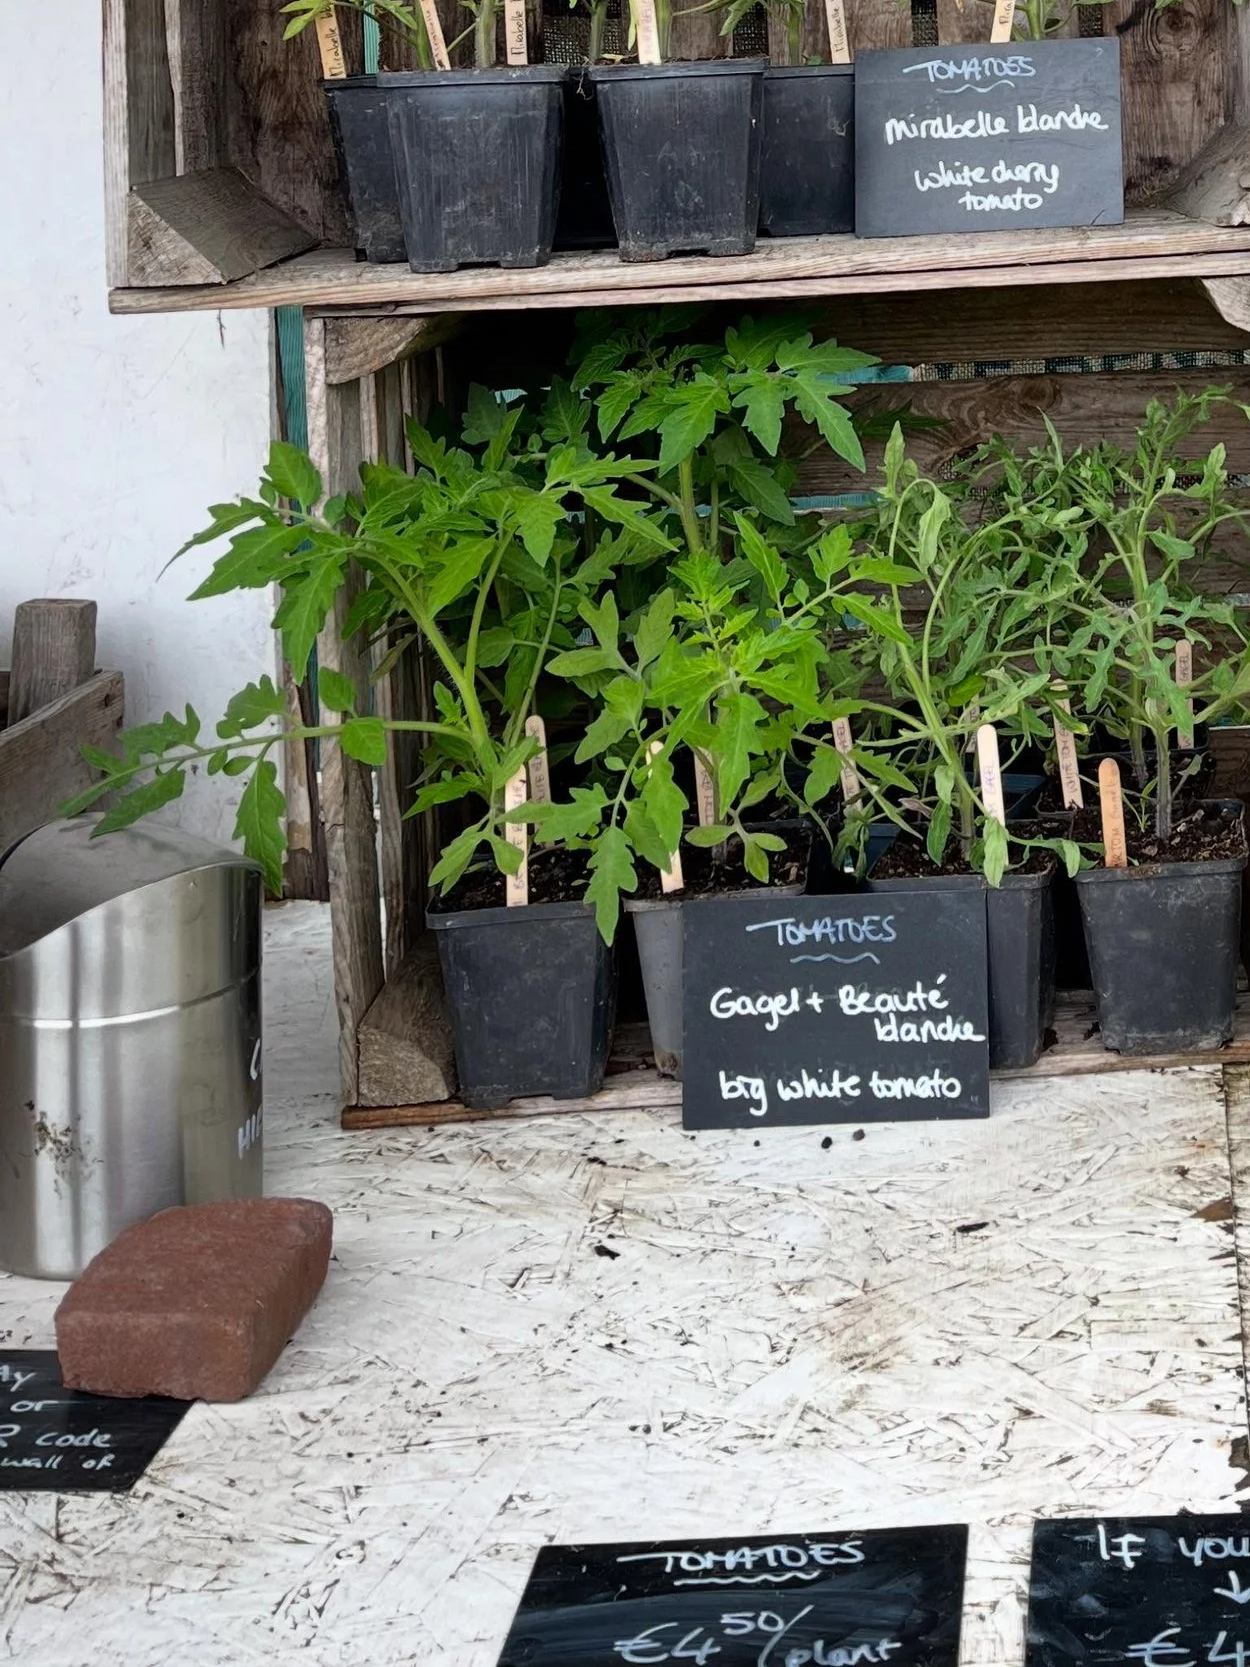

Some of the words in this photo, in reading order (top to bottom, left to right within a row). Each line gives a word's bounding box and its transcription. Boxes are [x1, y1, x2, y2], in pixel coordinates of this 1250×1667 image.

[902, 56, 1036, 83] TOMATOES
[1017, 103, 1109, 134] blanche
[914, 161, 989, 192] white
[991, 159, 1060, 194] cherry
[958, 187, 1043, 212] tomato
[745, 914, 898, 947] TOMATOES
[710, 987, 800, 1032] Gagel
[806, 994, 824, 1014] +
[838, 973, 949, 1016] Beauté
[874, 1014, 986, 1044] blanche
[718, 1070, 767, 1117] big
[776, 1068, 861, 1102] white
[868, 1068, 962, 1099] tomato
[35, 1428, 112, 1448] code
[82, 1453, 115, 1470] of
[616, 1540, 866, 1574] TOMATOES
